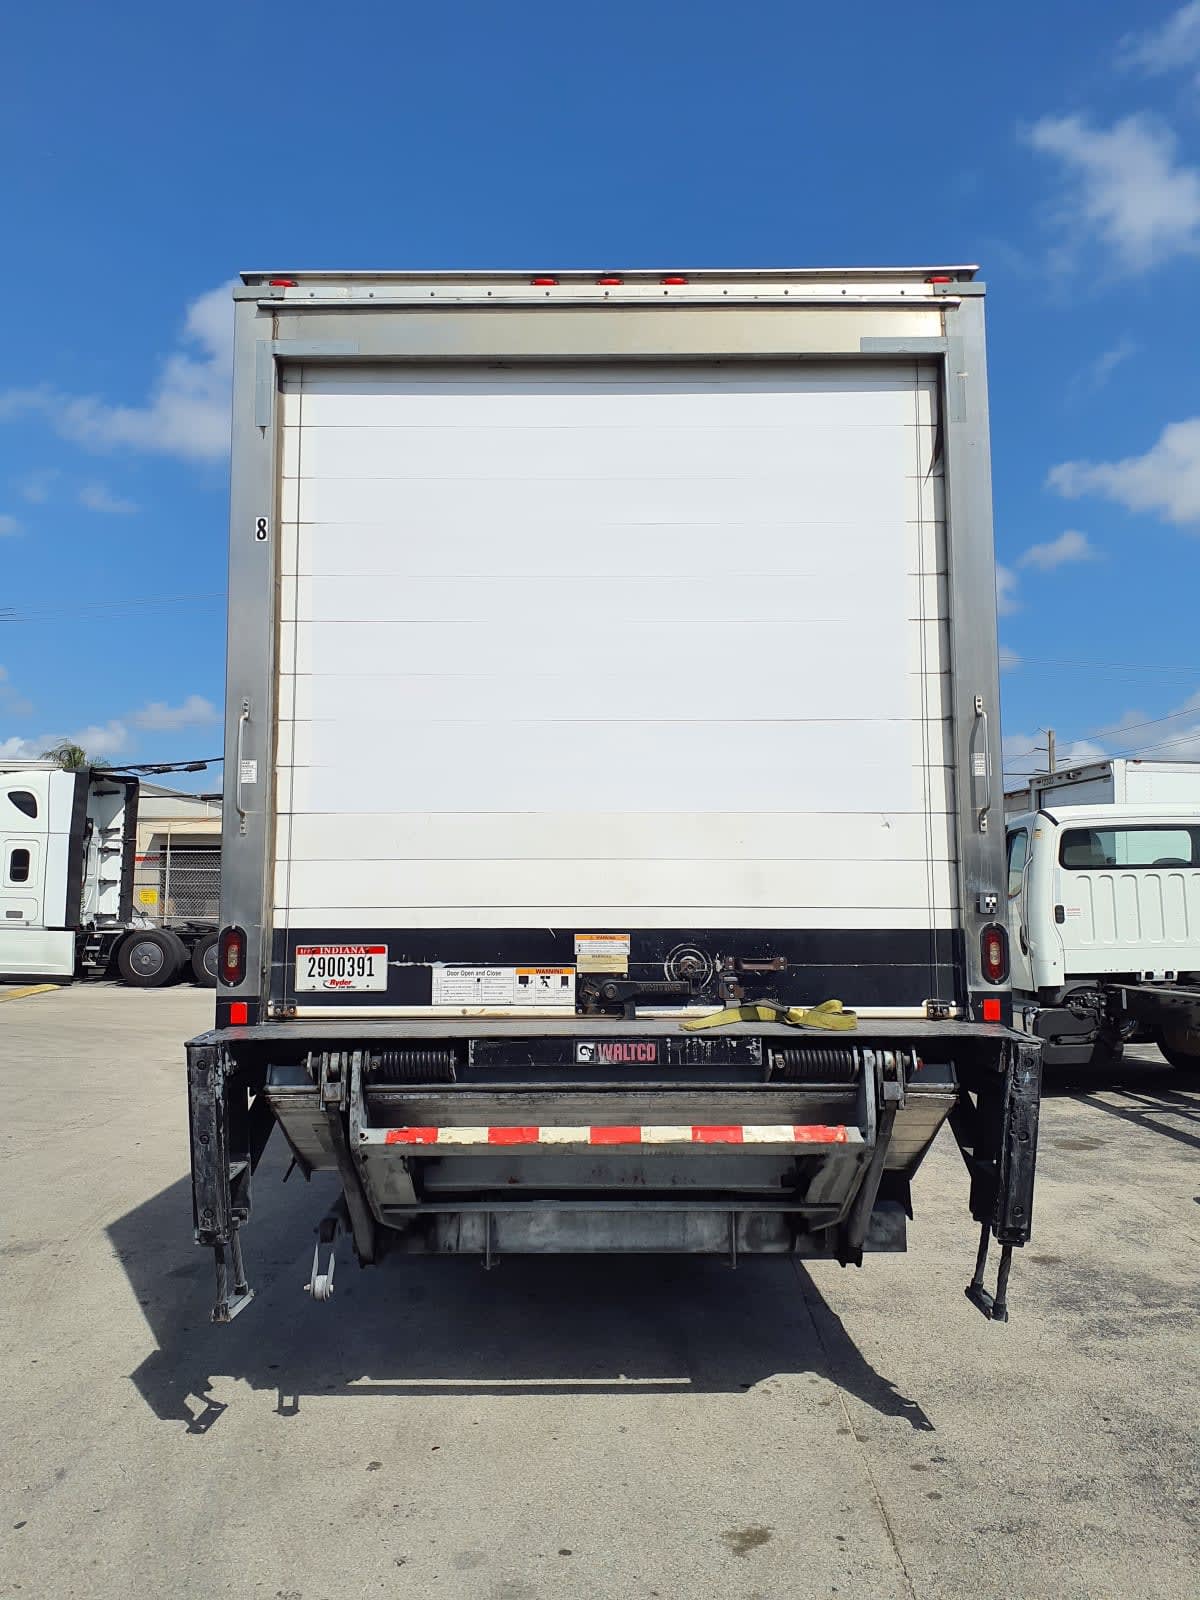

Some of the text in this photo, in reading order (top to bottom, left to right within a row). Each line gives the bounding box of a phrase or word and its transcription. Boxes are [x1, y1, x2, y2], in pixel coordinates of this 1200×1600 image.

[256, 518, 267, 540] 8
[319, 946, 366, 954] INDIANA
[308, 956, 374, 977] 2900391
[460, 970, 475, 978] Open
[329, 979, 352, 987] Ryder
[597, 1043, 657, 1062] WALTCO
